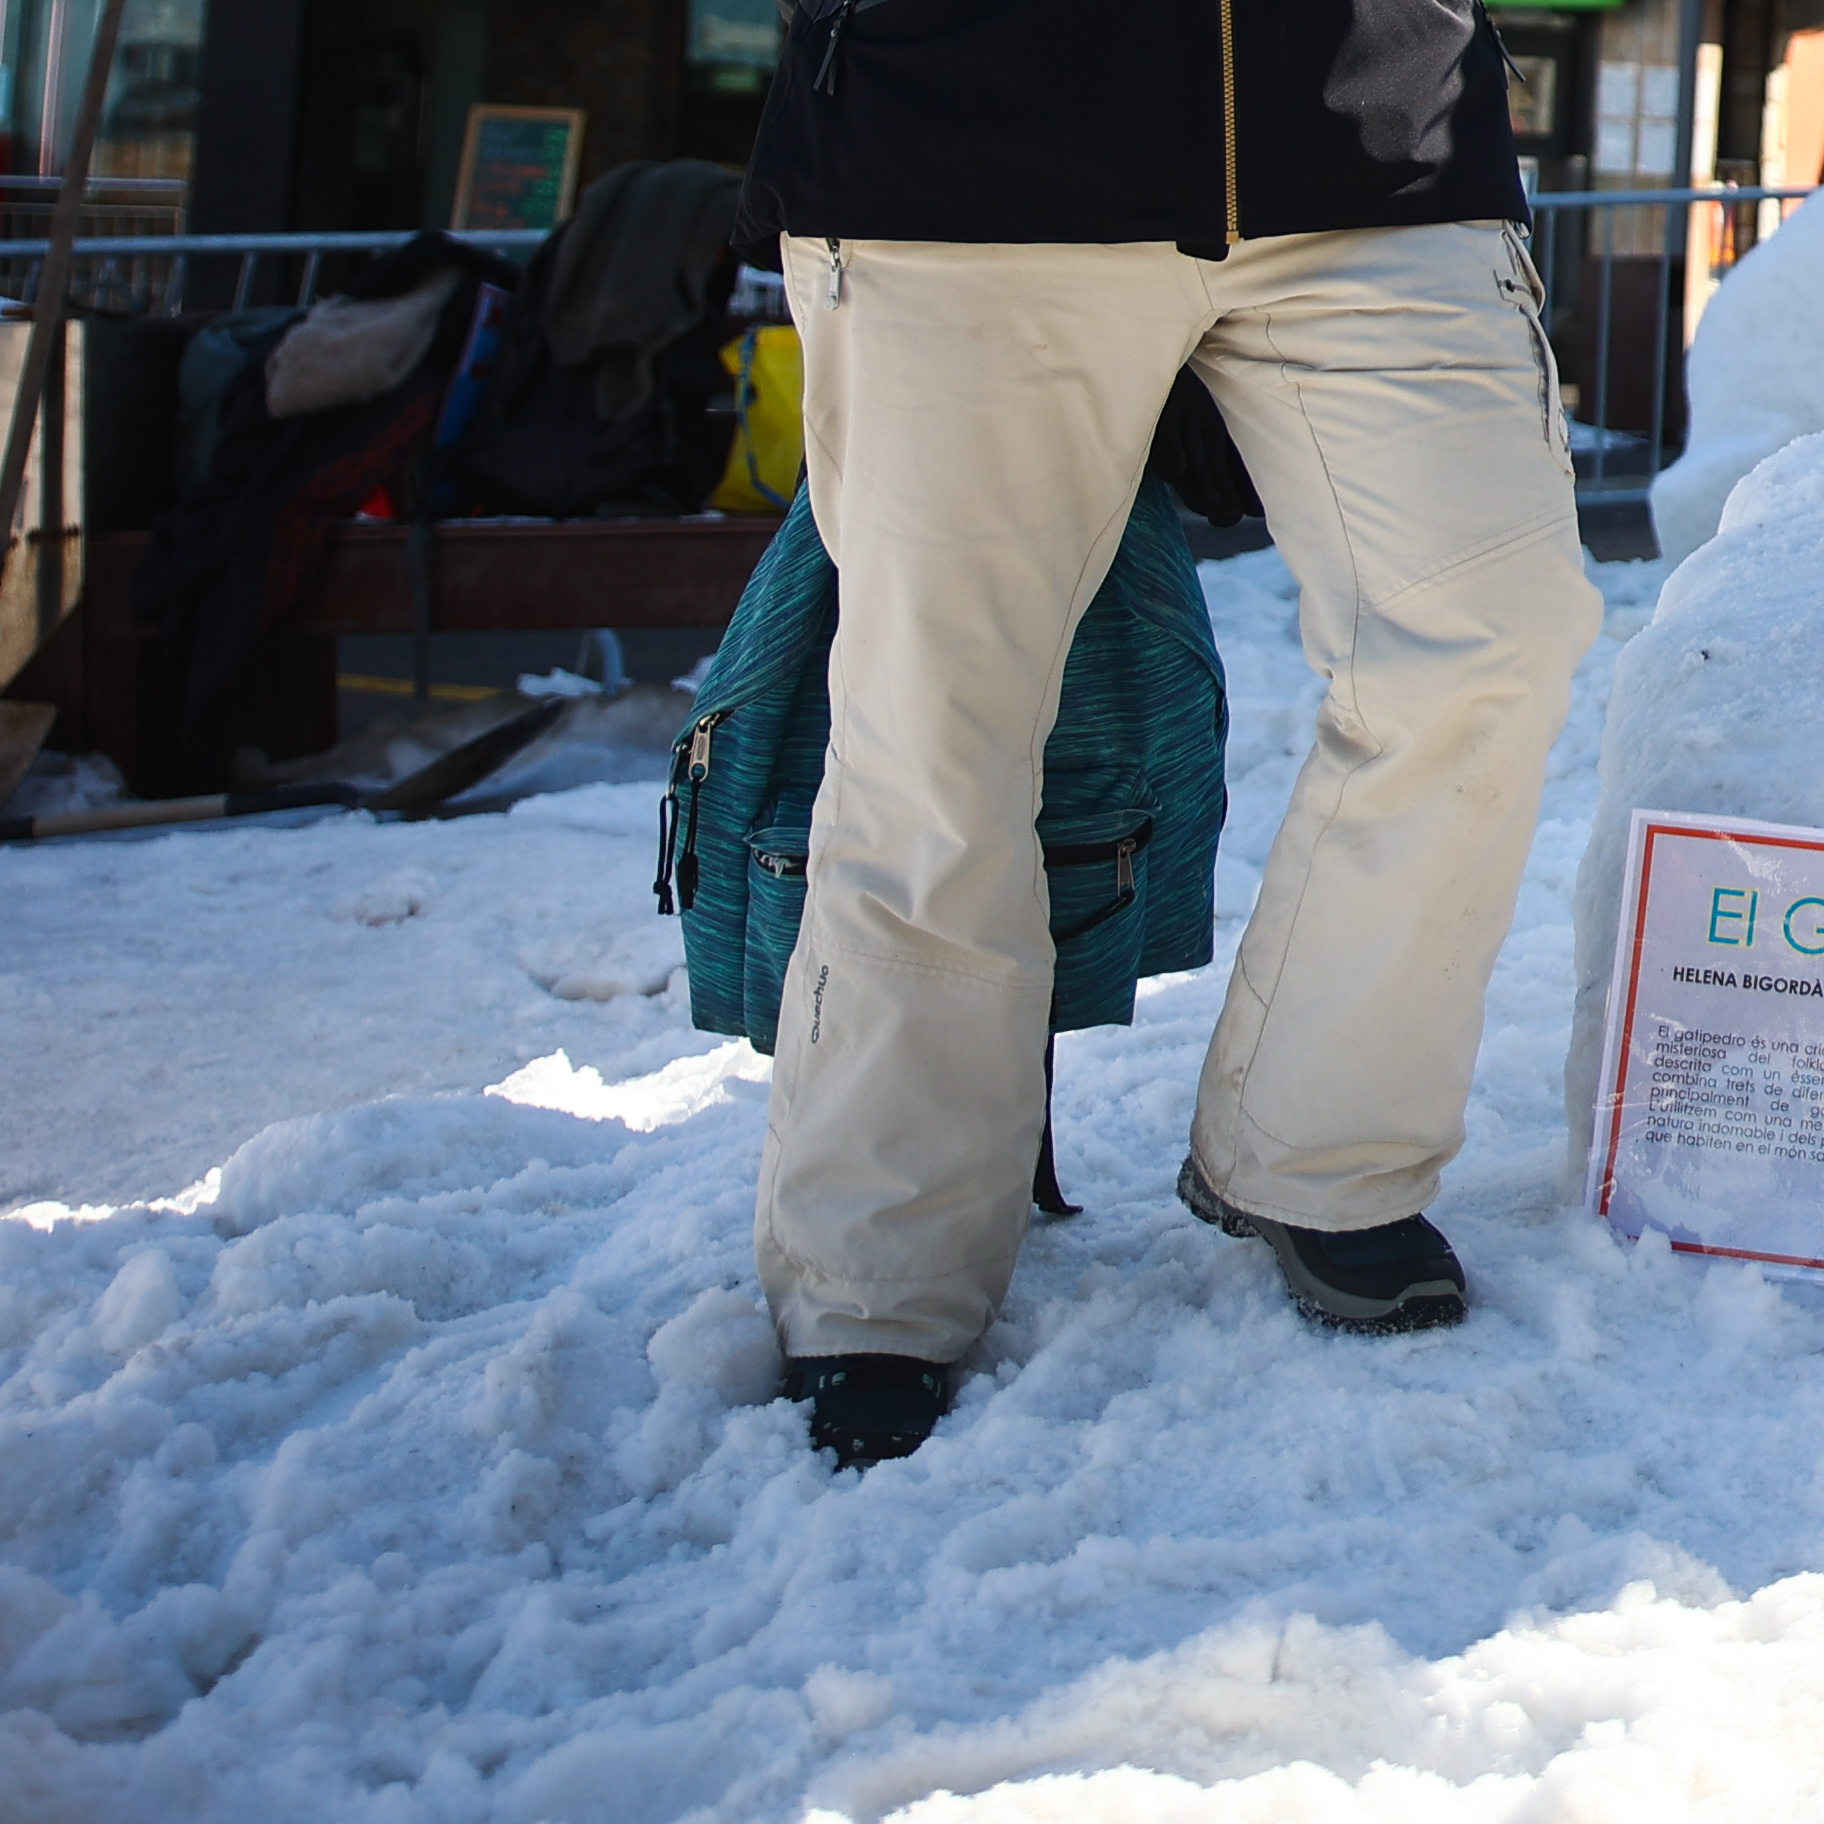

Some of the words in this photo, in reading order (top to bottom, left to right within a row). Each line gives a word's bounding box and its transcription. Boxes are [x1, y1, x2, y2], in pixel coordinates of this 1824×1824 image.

[1708, 887, 1759, 948] El
[1673, 966, 1737, 988] HELENA
[1742, 974, 1824, 998] BIGORDÀ
[811, 964, 829, 1044] Quechua
[1655, 1041, 1727, 1060] misteriosa
[1748, 1051, 1771, 1065] del
[1658, 1025, 1670, 1038] El
[1674, 1028, 1746, 1047] gatipedro
[1751, 1035, 1767, 1050] és
[1771, 1040, 1799, 1054] una
[1654, 1056, 1712, 1073] descrita
[1722, 1064, 1753, 1077] com
[1763, 1069, 1781, 1081] un
[1652, 1071, 1718, 1088] combina
[1726, 1078, 1756, 1093] trets
[1764, 1083, 1784, 1096] de
[1650, 1087, 1750, 1108] principalment
[1770, 1099, 1790, 1112] de
[1647, 1115, 1694, 1131] natura
[1699, 1119, 1776, 1140] indomable
[1788, 1131, 1816, 1145] dels
[1725, 1110, 1757, 1123] com
[1765, 1115, 1792, 1128] una
[1645, 1130, 1672, 1144] que
[1677, 1131, 1732, 1151] habiten
[1735, 1141, 1754, 1154] en
[1758, 1142, 1771, 1157] el
[1774, 1146, 1807, 1158] món
